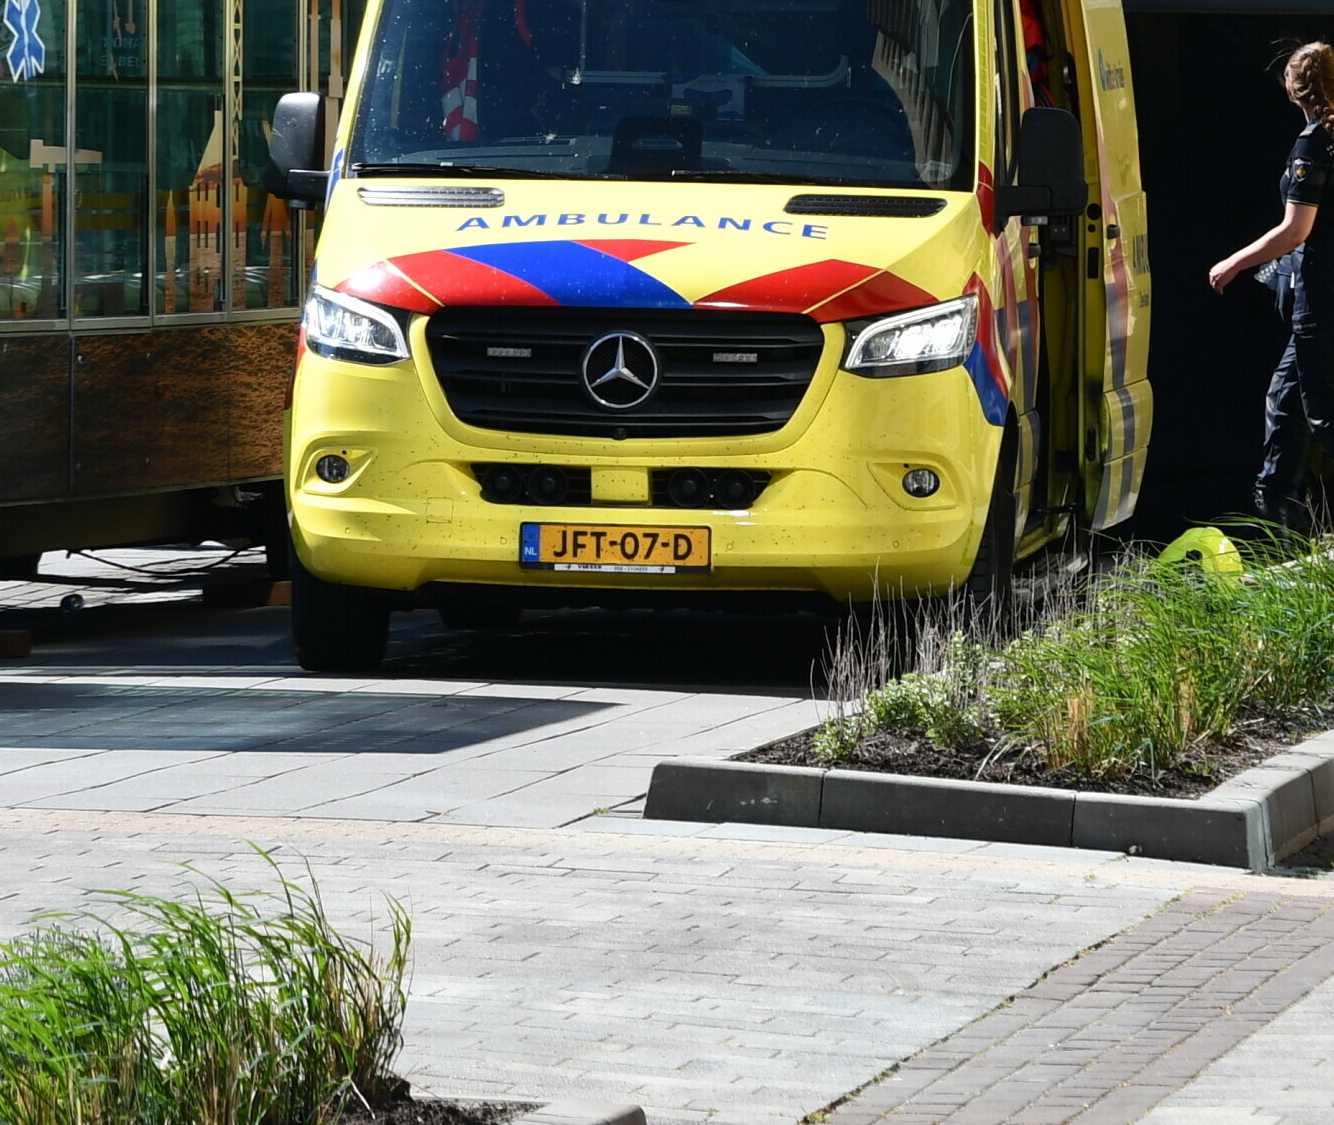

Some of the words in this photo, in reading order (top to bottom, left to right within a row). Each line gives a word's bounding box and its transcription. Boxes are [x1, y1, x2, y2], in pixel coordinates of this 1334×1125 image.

[455, 213, 829, 240] AMBULANCE
[524, 546, 537, 556] NL
[553, 530, 693, 561] JFT-07-D
